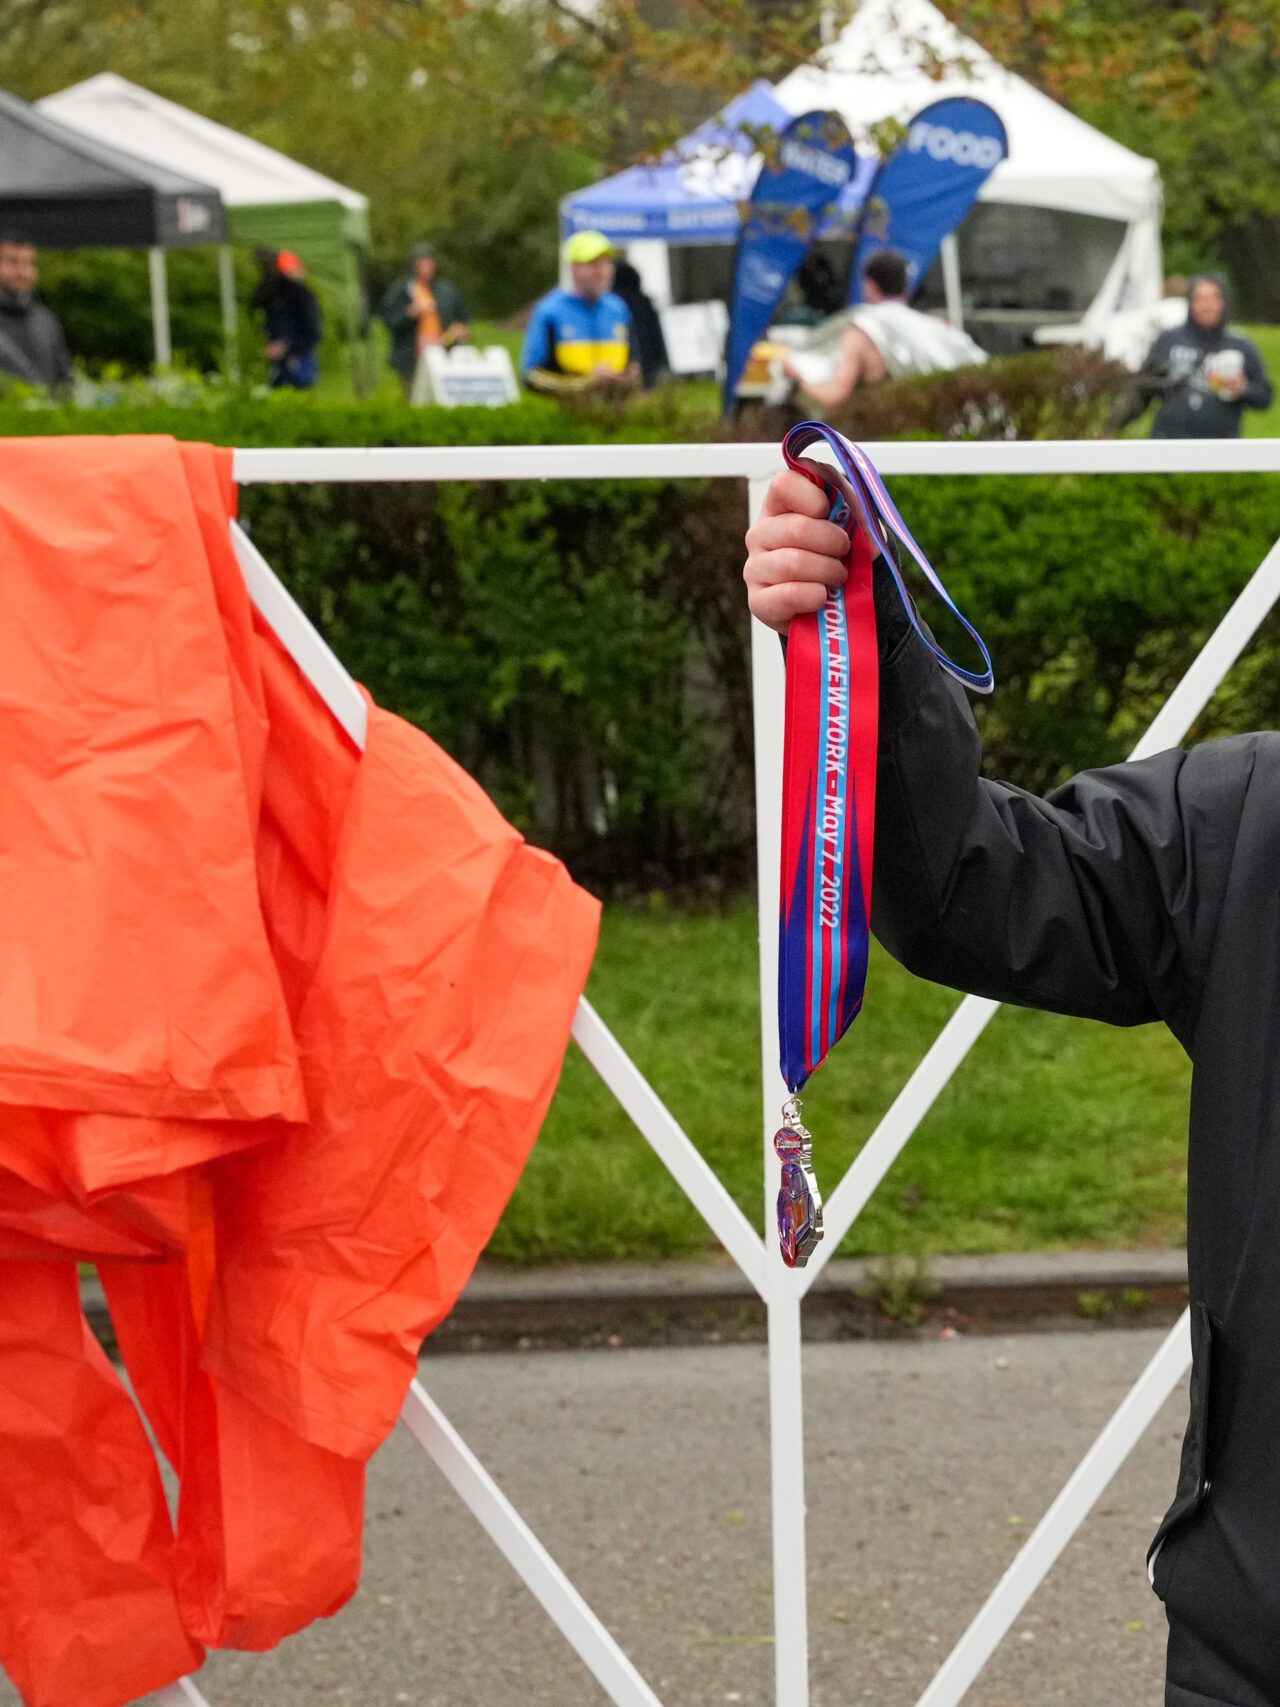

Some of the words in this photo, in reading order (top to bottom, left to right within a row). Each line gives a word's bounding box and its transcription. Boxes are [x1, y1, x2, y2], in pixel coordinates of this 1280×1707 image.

[907, 121, 1003, 169] FOOD
[823, 586, 846, 645] PTON,
[826, 652, 848, 710] NEW
[824, 715, 848, 776] YORK
[816, 794, 844, 845] May
[818, 850, 842, 867] 7,
[818, 873, 842, 929] 2022
